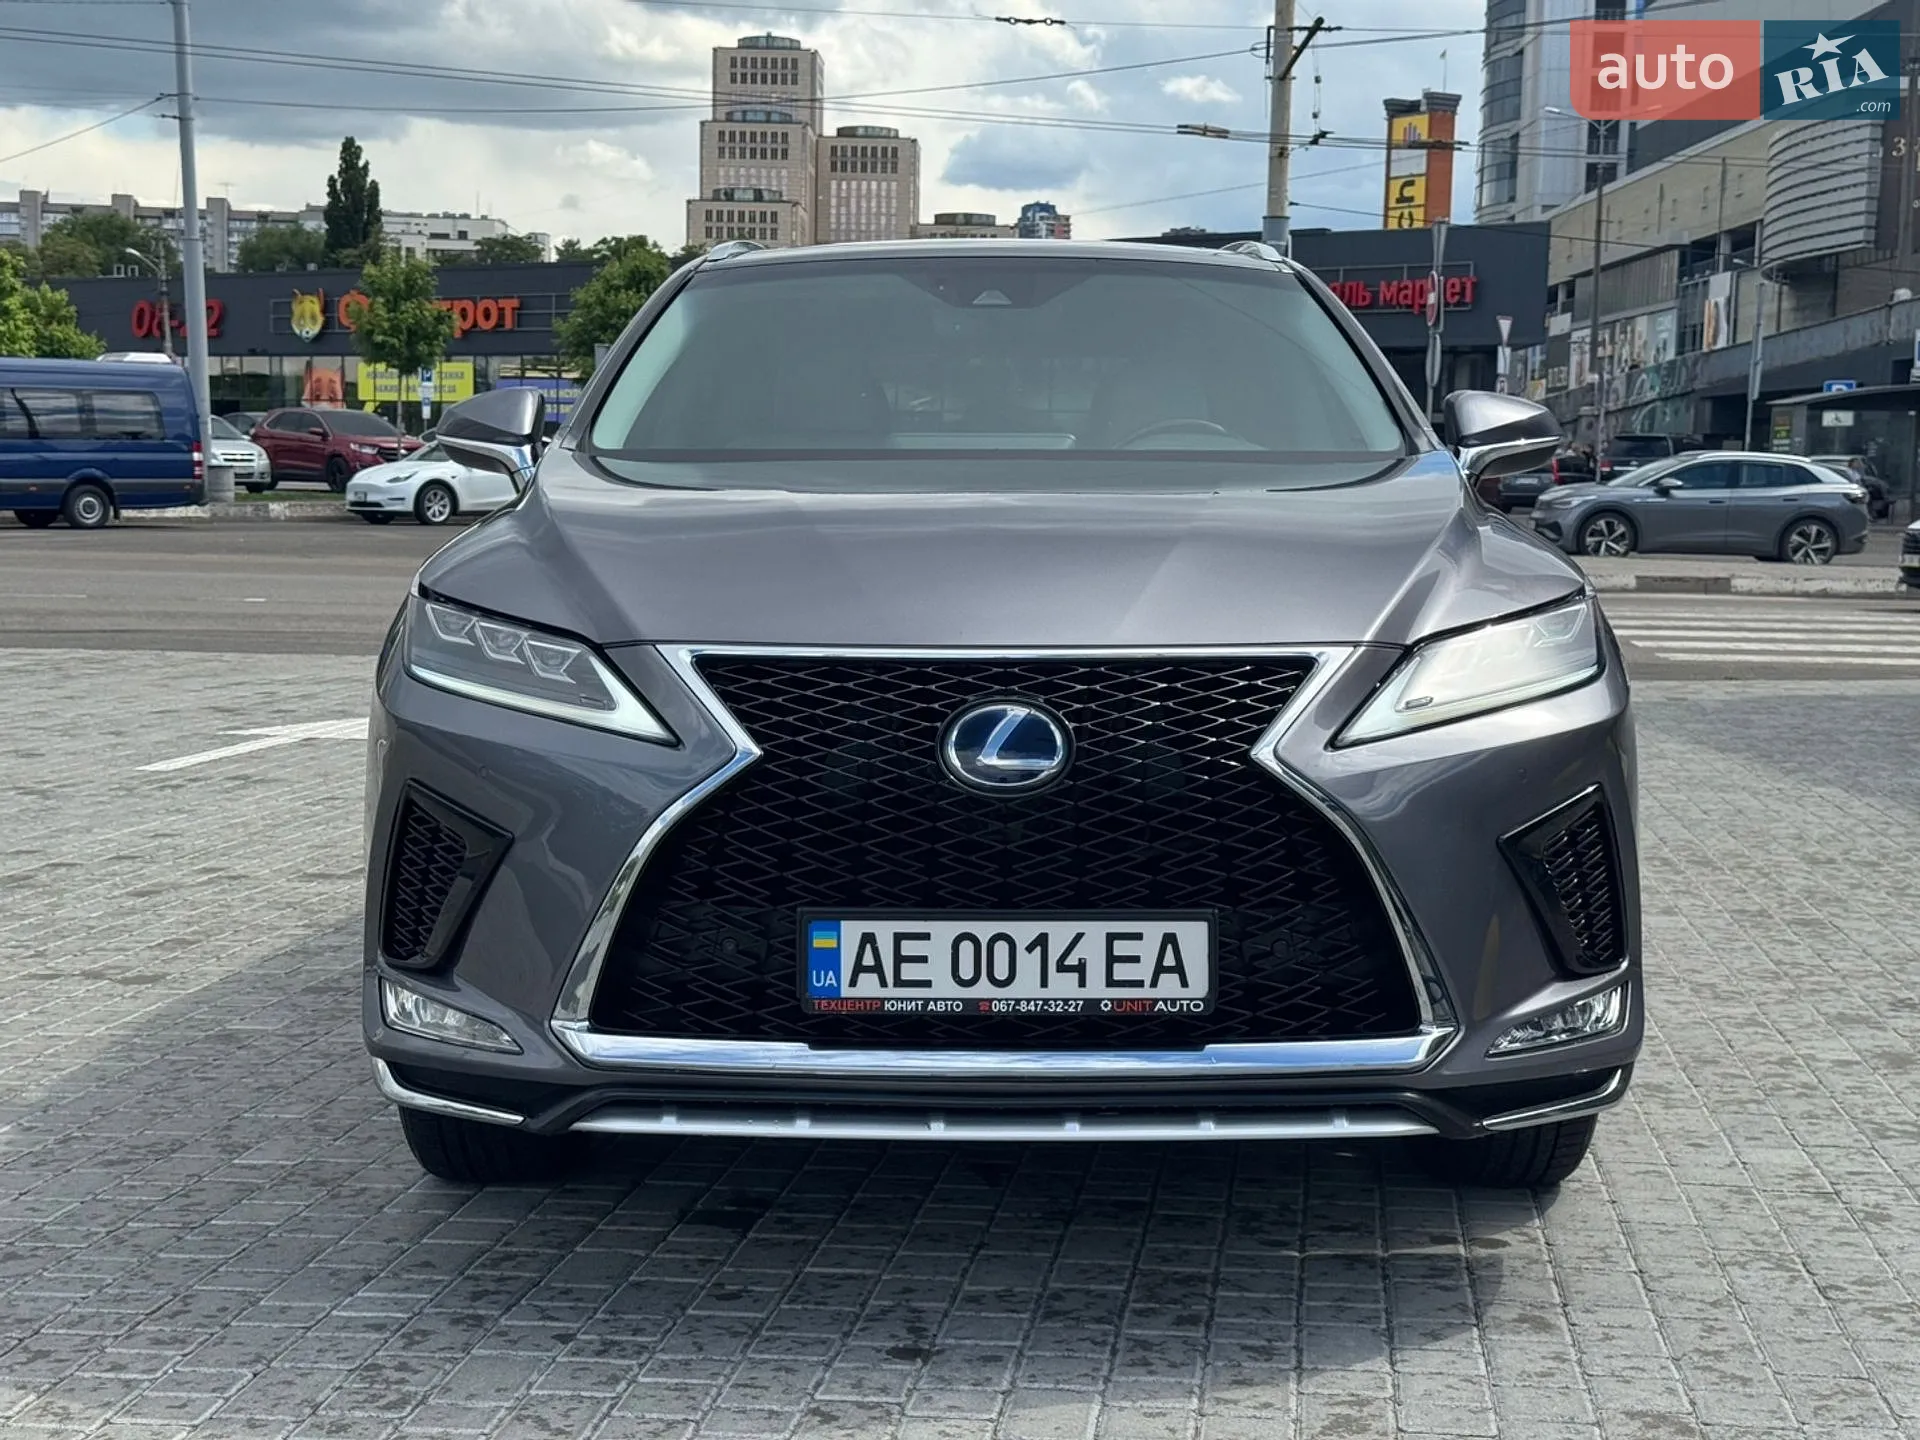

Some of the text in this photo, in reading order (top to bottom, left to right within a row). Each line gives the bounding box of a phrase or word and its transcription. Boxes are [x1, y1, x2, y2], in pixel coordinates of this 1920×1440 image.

[1379, 276, 1477, 314] марет
[848, 932, 1189, 988] AE 0014 EA
[813, 970, 837, 987] UA
[814, 1001, 881, 1012] ТЕХЦЕНТР
[884, 1000, 924, 1012] ЮНИТ
[927, 1001, 963, 1012] АВТО
[991, 1000, 1083, 1012] 067-847-32-27
